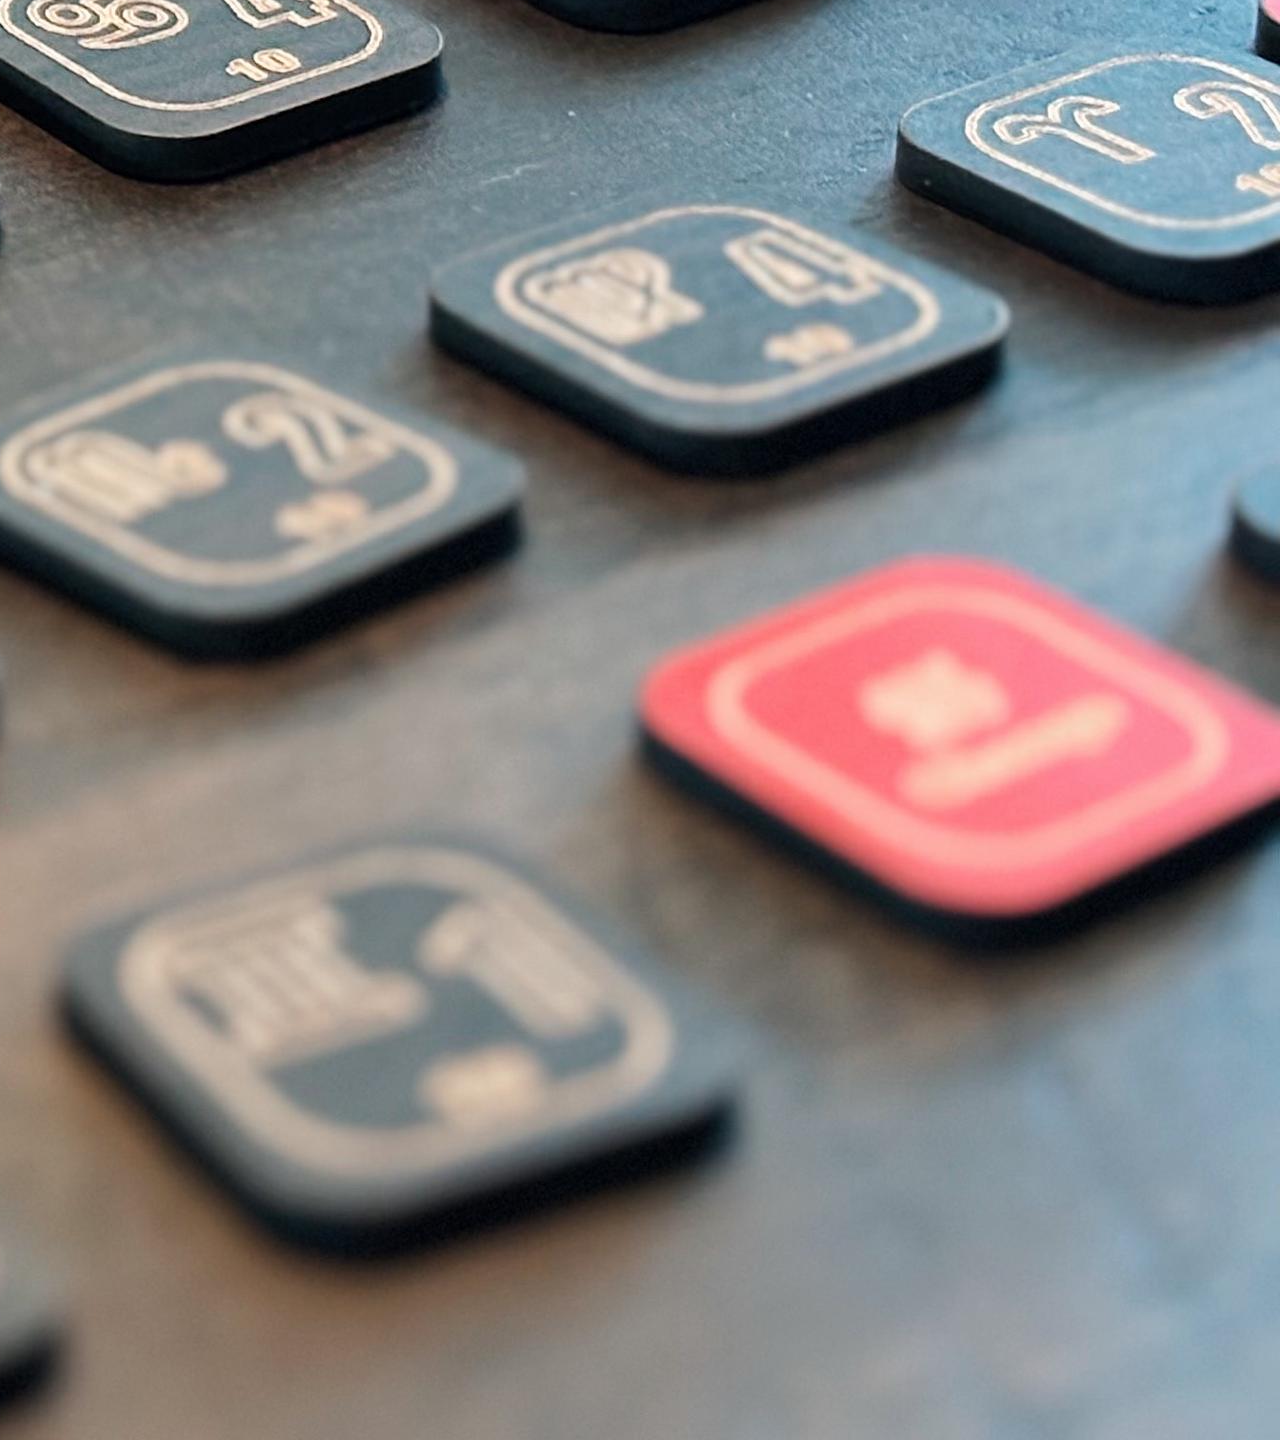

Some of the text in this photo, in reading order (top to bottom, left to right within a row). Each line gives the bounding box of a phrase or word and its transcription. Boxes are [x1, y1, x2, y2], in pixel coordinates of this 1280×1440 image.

[225, 47, 302, 82] 10
[1173, 80, 1280, 151] 2
[723, 229, 882, 307] 4
[221, 390, 396, 485] 2
